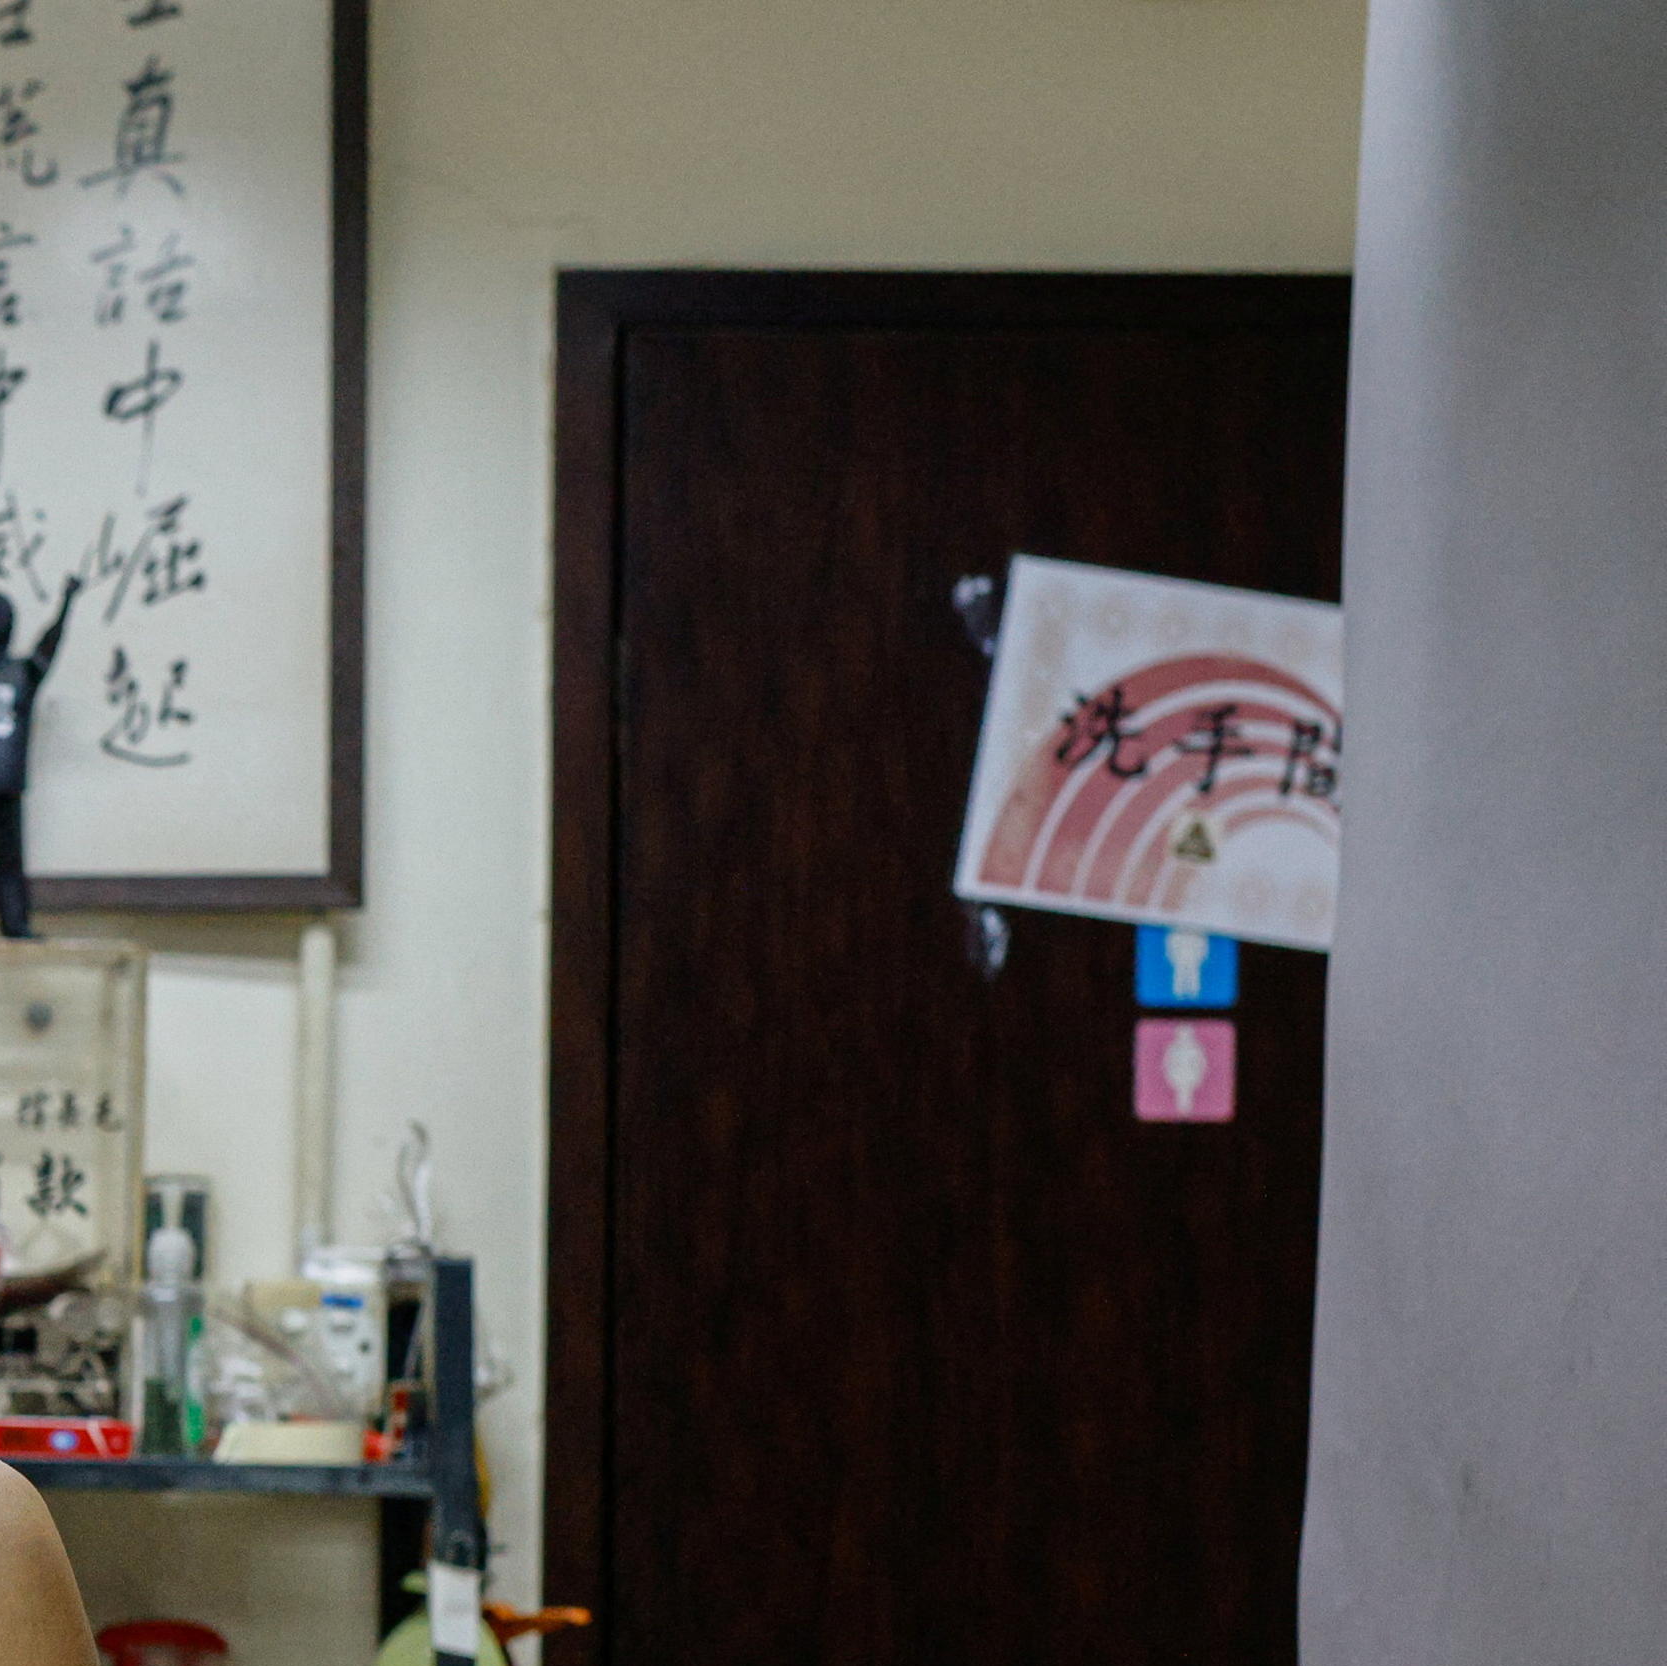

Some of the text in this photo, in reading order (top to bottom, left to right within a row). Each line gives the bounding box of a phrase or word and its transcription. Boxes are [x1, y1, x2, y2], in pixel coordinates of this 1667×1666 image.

[78, 0, 207, 767] 真話中崛起
